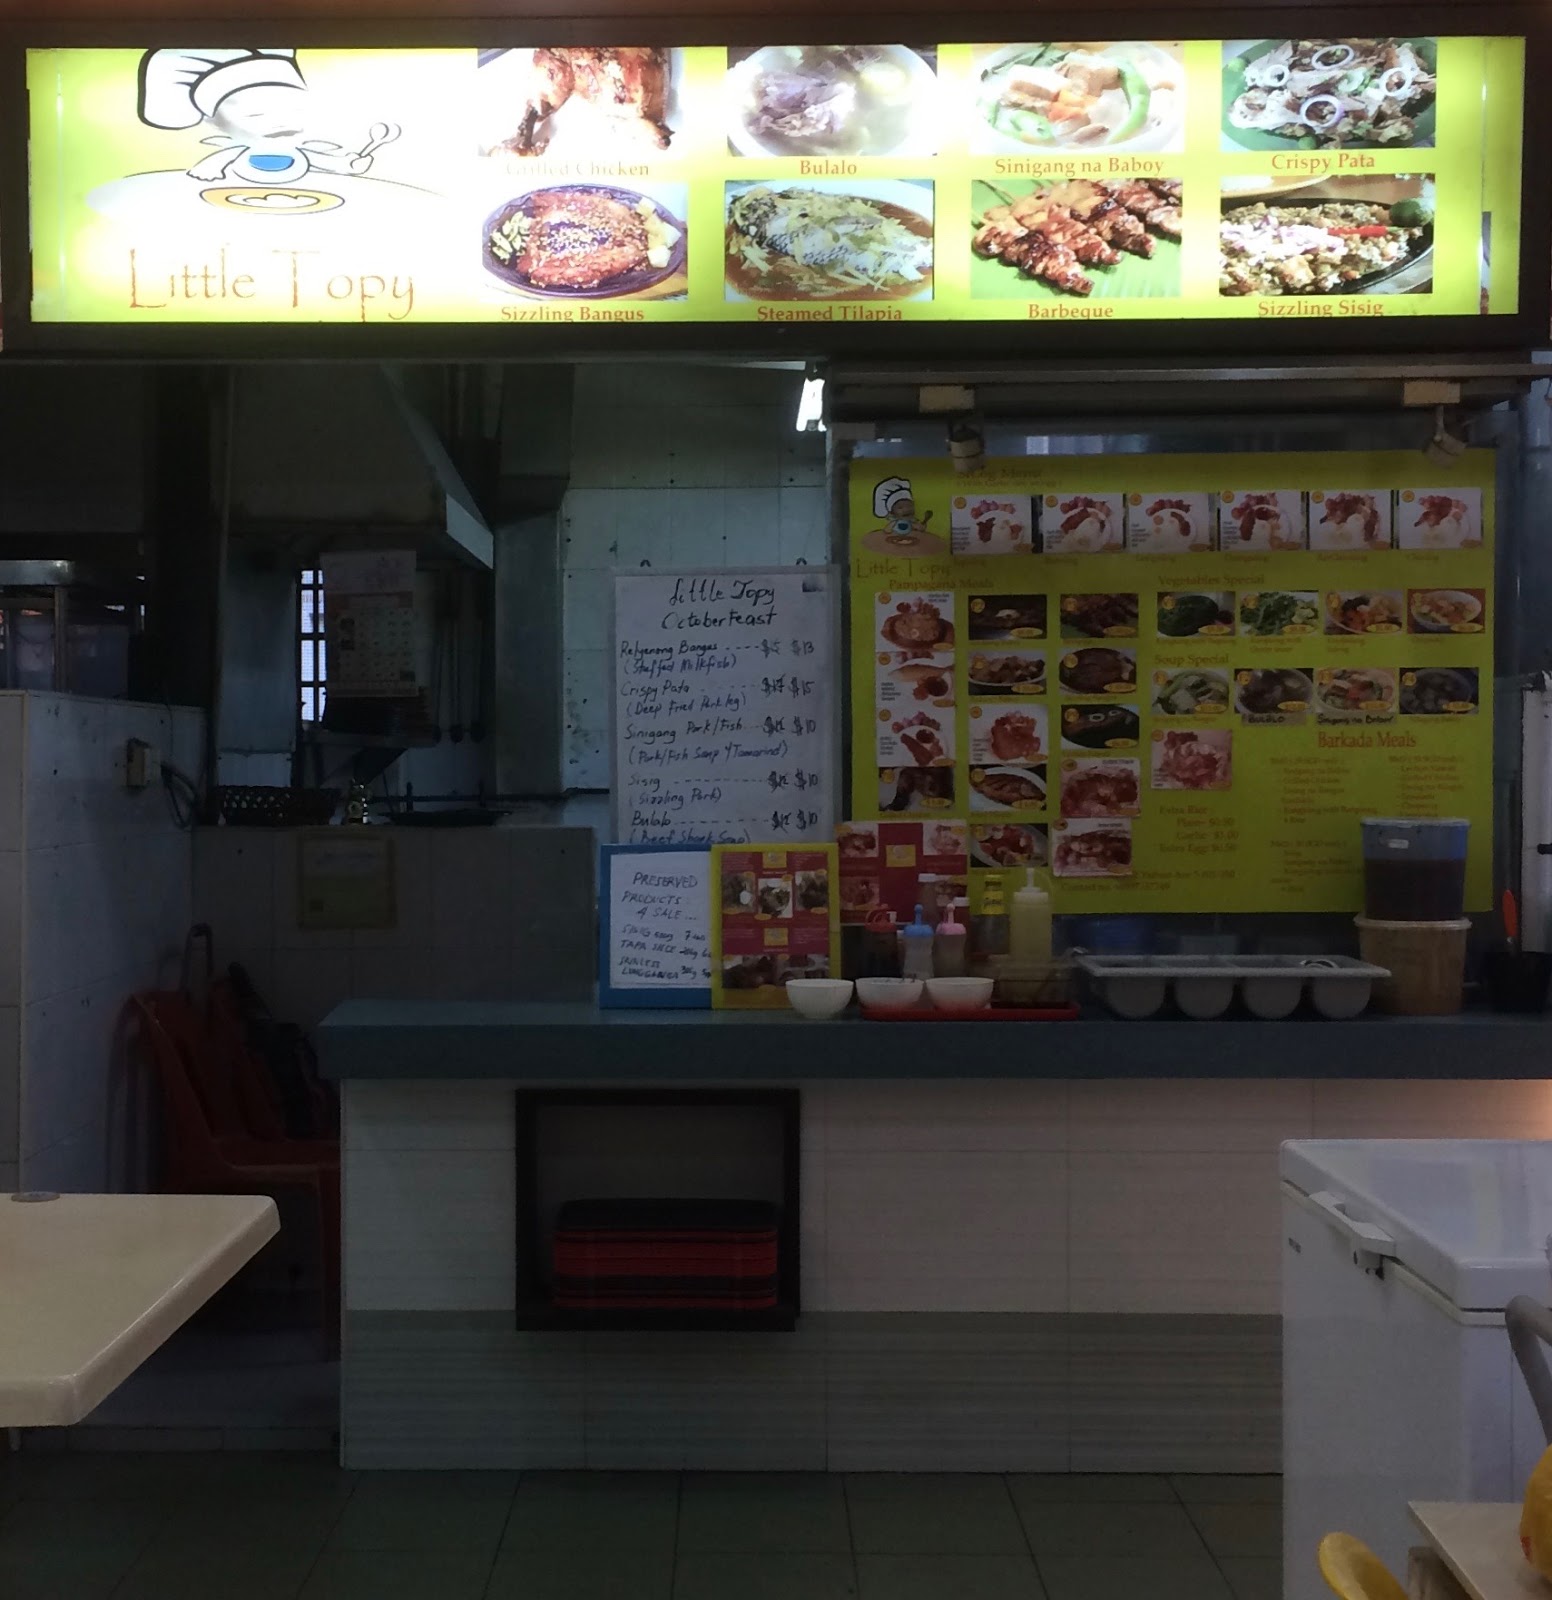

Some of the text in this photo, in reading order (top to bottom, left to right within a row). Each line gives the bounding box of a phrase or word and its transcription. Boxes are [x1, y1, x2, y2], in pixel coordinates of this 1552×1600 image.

[576, 161, 649, 176] Chicken
[799, 159, 857, 175] Bulalo
[995, 157, 1163, 178] Sinigang na Baboy
[1272, 153, 1376, 172] Crispy Pata
[129, 243, 415, 322] Little Topy
[500, 306, 645, 322] Sizzling Bangus
[757, 305, 903, 322] Steamed Tilapia
[1027, 303, 1114, 320] Barbeque
[1258, 300, 1385, 318] Sizzling Sisig
[856, 558, 897, 579] Little
[1224, 574, 1265, 586] Special
[669, 578, 775, 607] Little Topy
[661, 605, 778, 630] October Feast
[1317, 729, 1417, 748] Barkada Meals
[632, 871, 698, 889] PRESERVED
[621, 890, 683, 905] PRODUCTS
